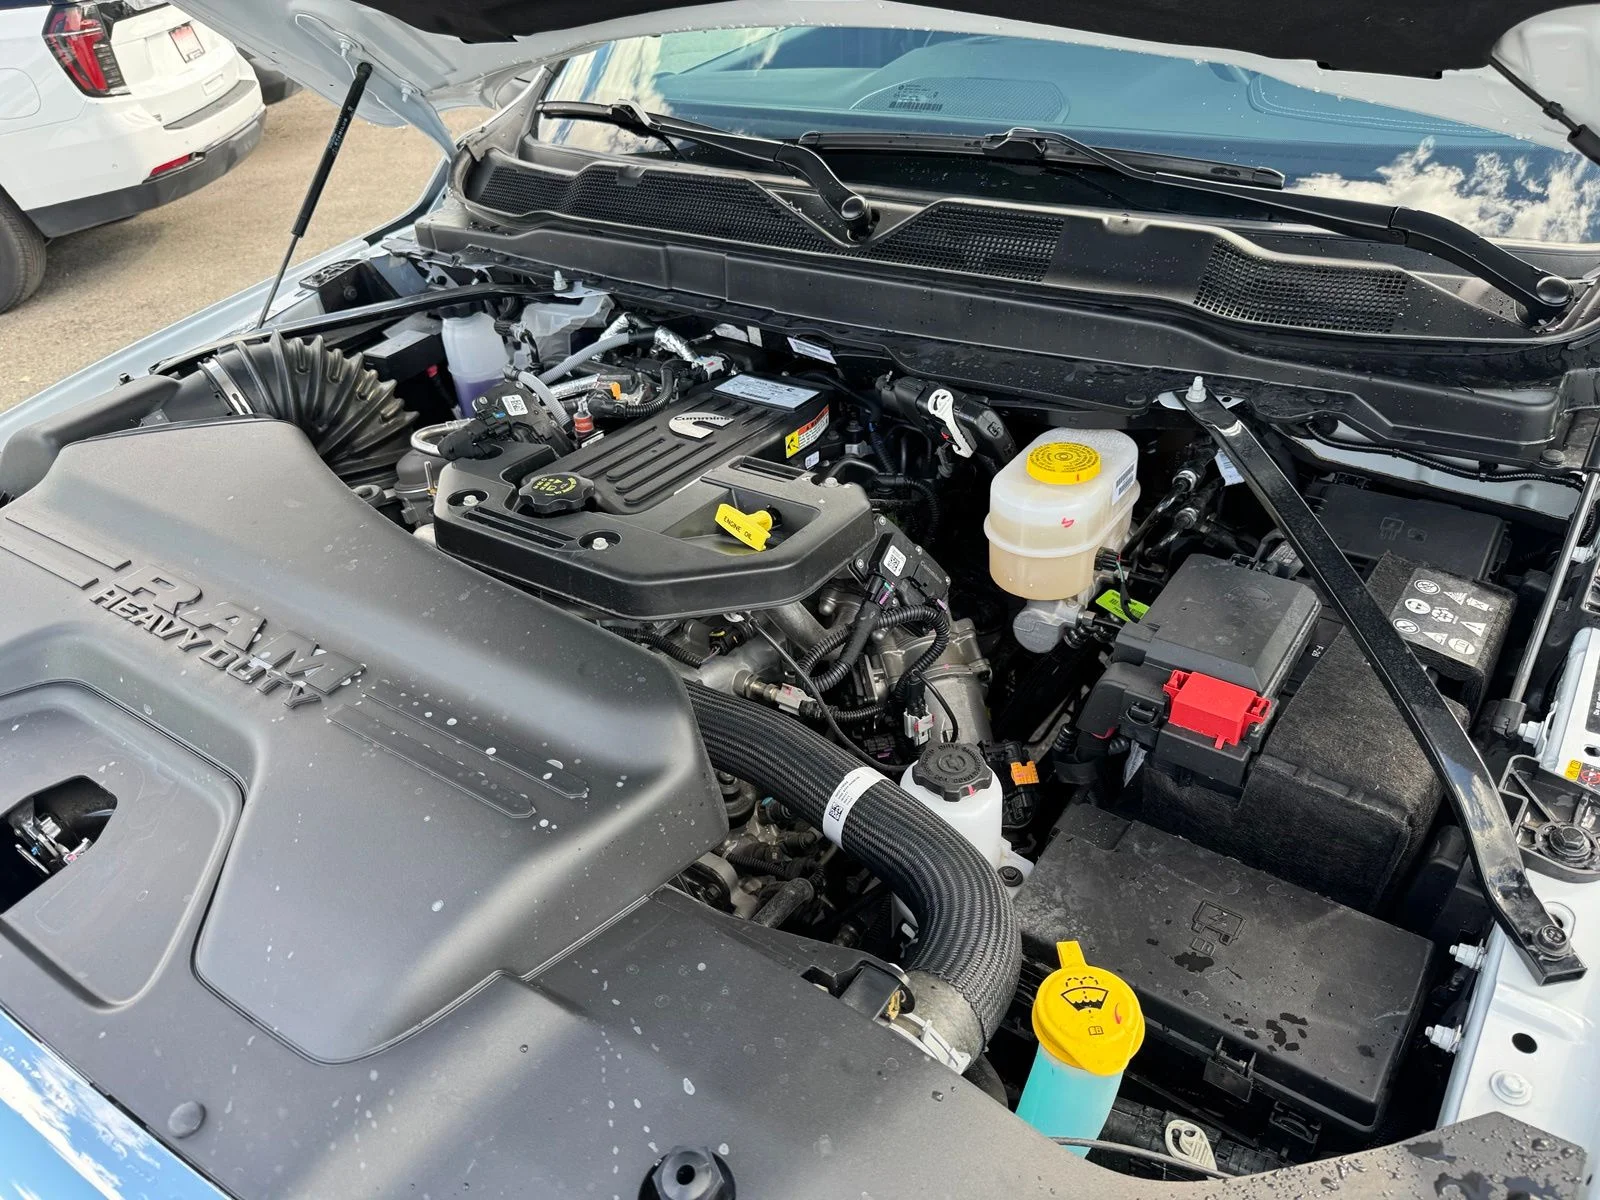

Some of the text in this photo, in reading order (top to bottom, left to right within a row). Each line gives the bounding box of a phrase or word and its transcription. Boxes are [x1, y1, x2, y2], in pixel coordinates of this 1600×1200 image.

[723, 515, 753, 541] ENGINE OIL
[89, 588, 322, 709] HEAVY DUTY
[113, 564, 367, 694] RAM
